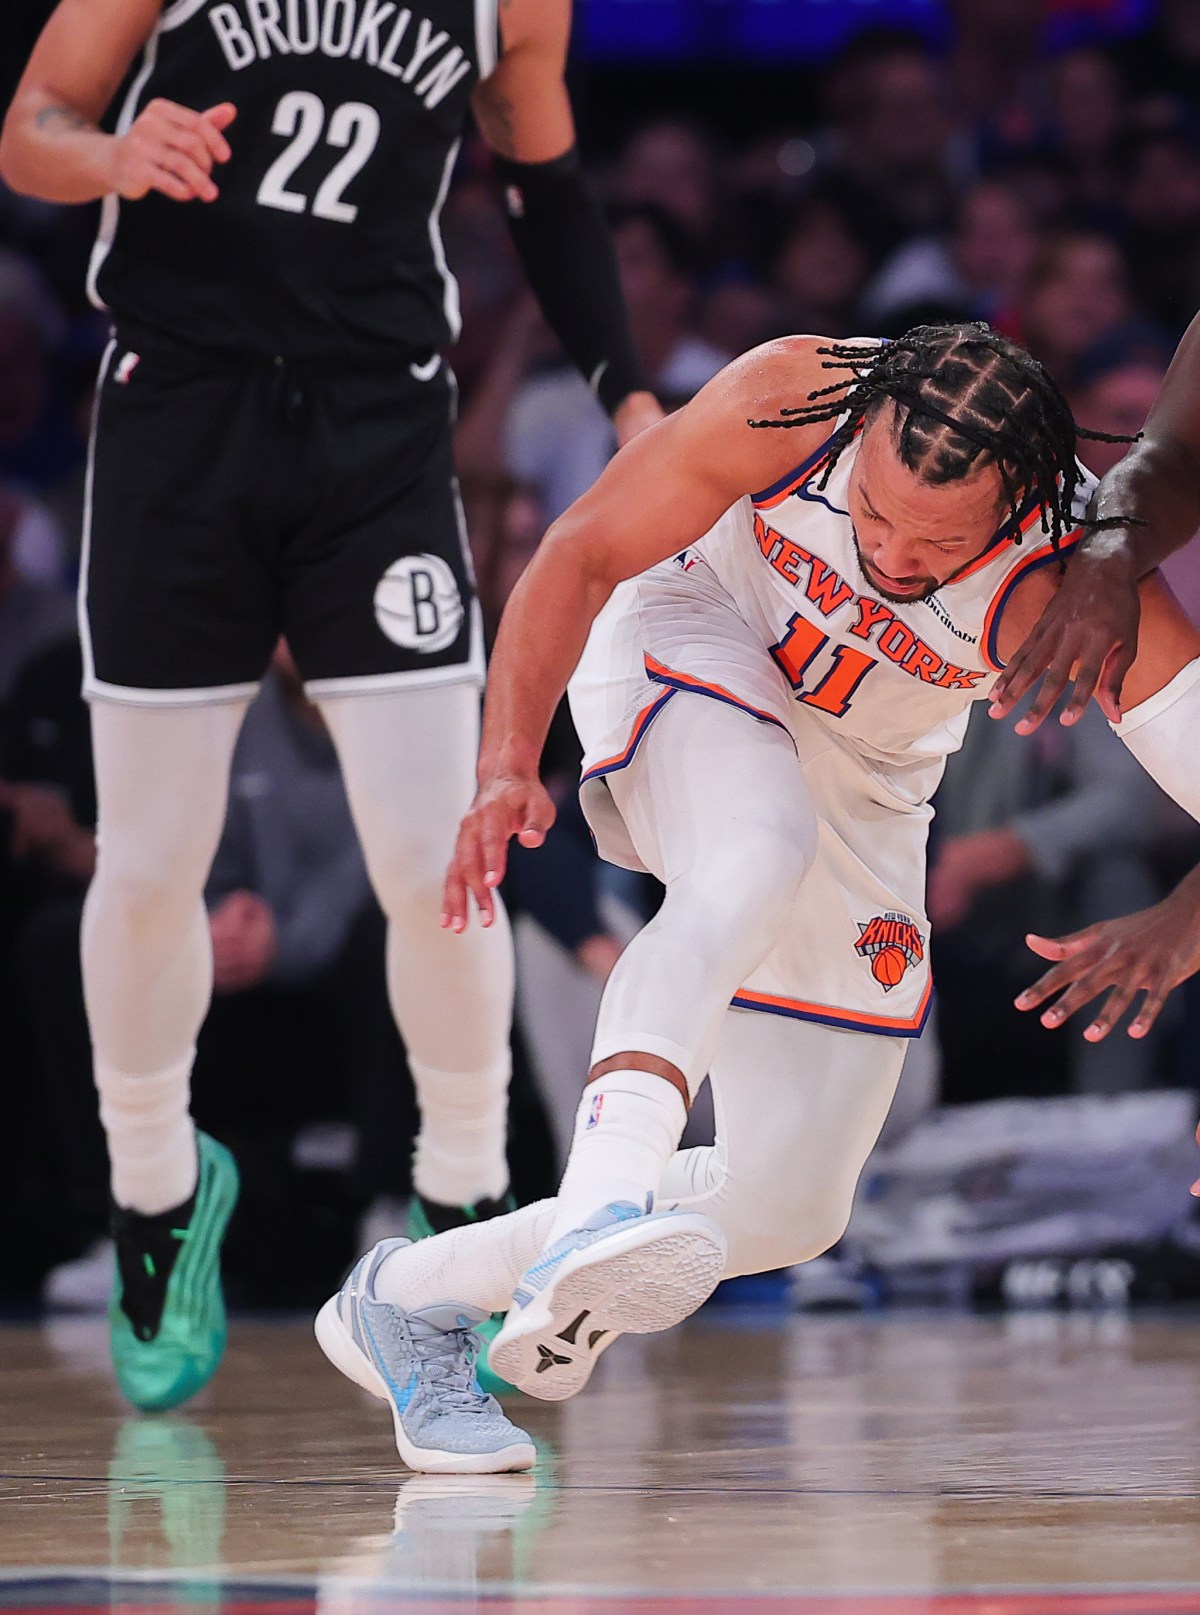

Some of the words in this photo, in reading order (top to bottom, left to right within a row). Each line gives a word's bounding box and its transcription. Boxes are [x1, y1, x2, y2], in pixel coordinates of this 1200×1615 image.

[208, 0, 471, 110] BROOKLYN
[256, 90, 381, 224] 22
[753, 511, 853, 619] NEW
[848, 594, 989, 690] YORK
[768, 611, 879, 718] 11
[854, 916, 924, 961] KNICKS
